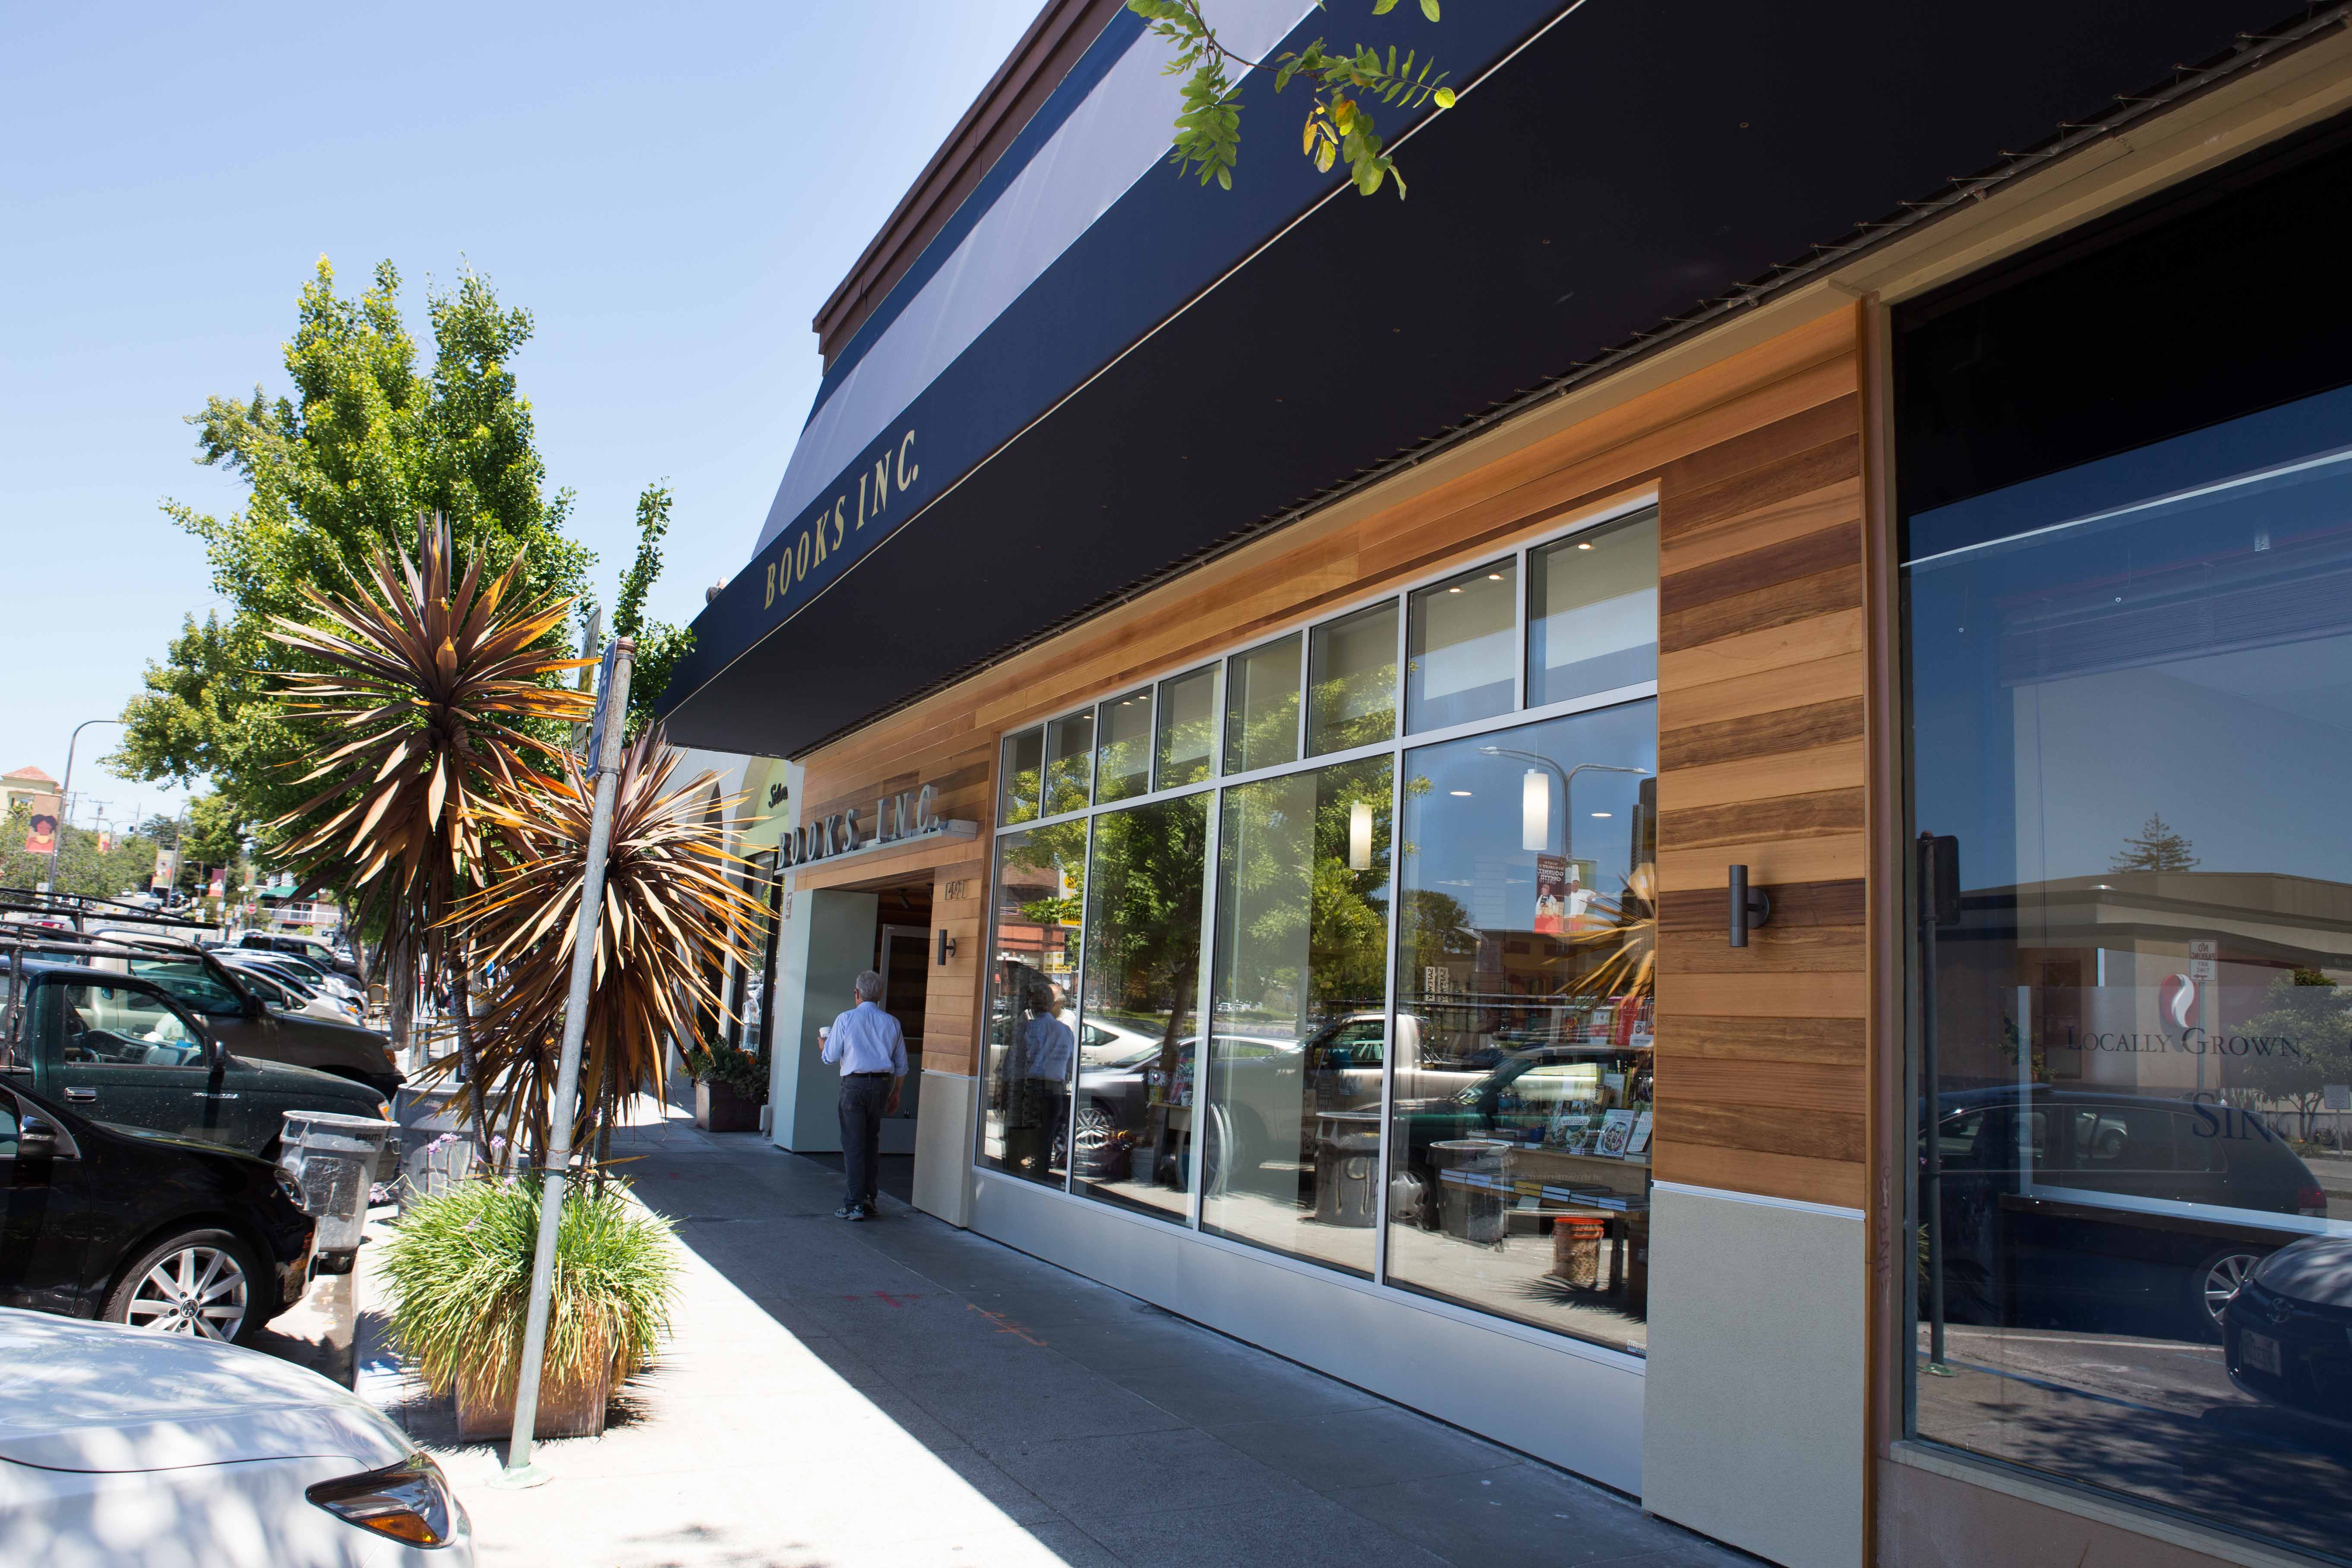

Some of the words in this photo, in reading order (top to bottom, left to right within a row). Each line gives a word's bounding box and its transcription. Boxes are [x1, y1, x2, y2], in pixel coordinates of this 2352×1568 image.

[764, 495, 846, 610] BOOKS
[856, 430, 919, 531] INC.
[777, 808, 859, 869] BOOKS
[875, 784, 939, 844] INC.
[2066, 1026, 2174, 1053] LOCALLY
[2181, 1028, 2312, 1063] GROWN,
